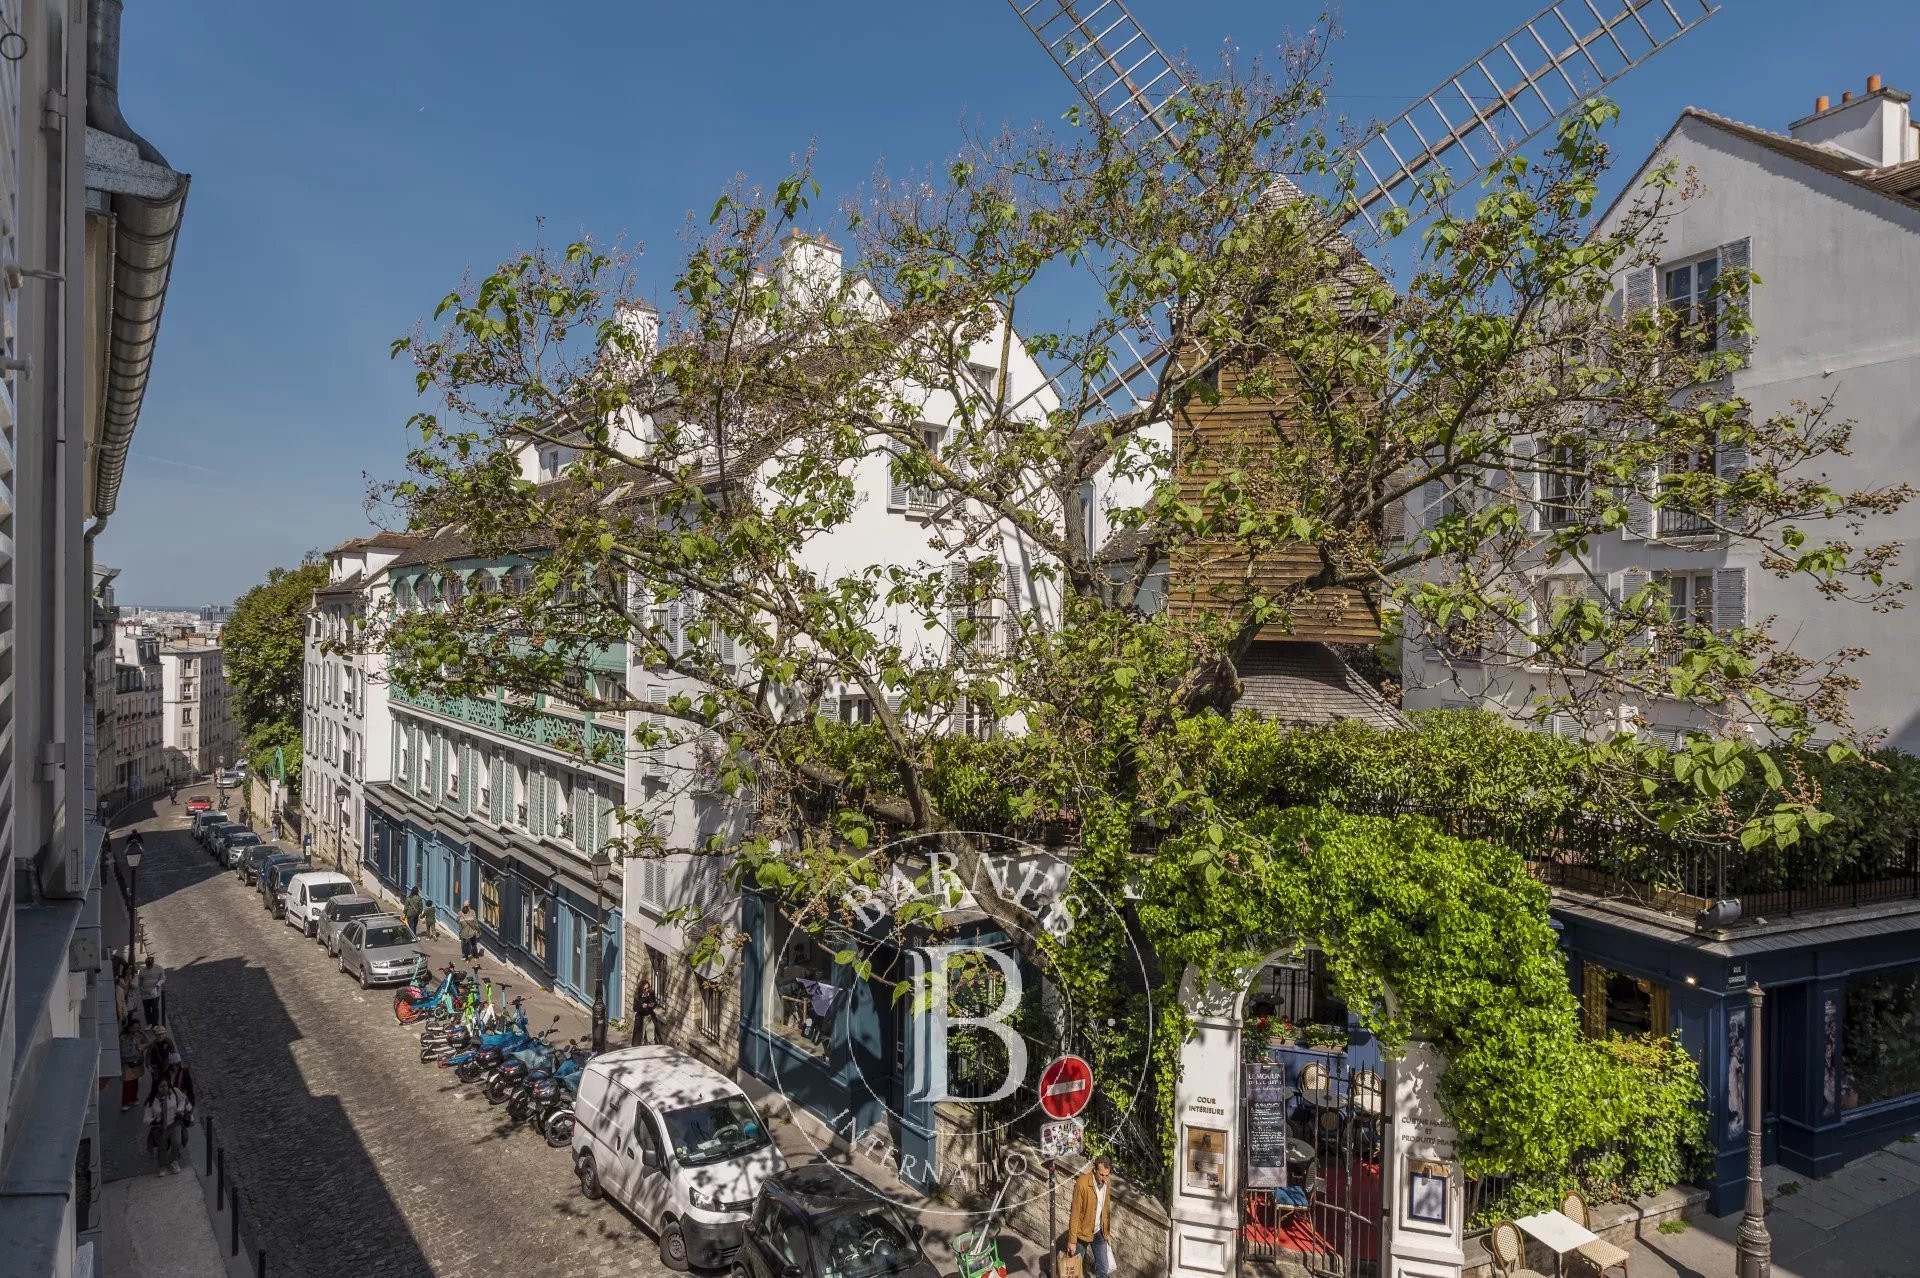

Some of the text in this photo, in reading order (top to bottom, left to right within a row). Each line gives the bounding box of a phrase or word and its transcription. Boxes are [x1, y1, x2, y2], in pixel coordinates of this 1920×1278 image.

[1189, 1105, 1224, 1115] INTÉRIEURE
[1430, 1120, 1453, 1128] MAISO
[1402, 1135, 1435, 1144] PRODUITS
